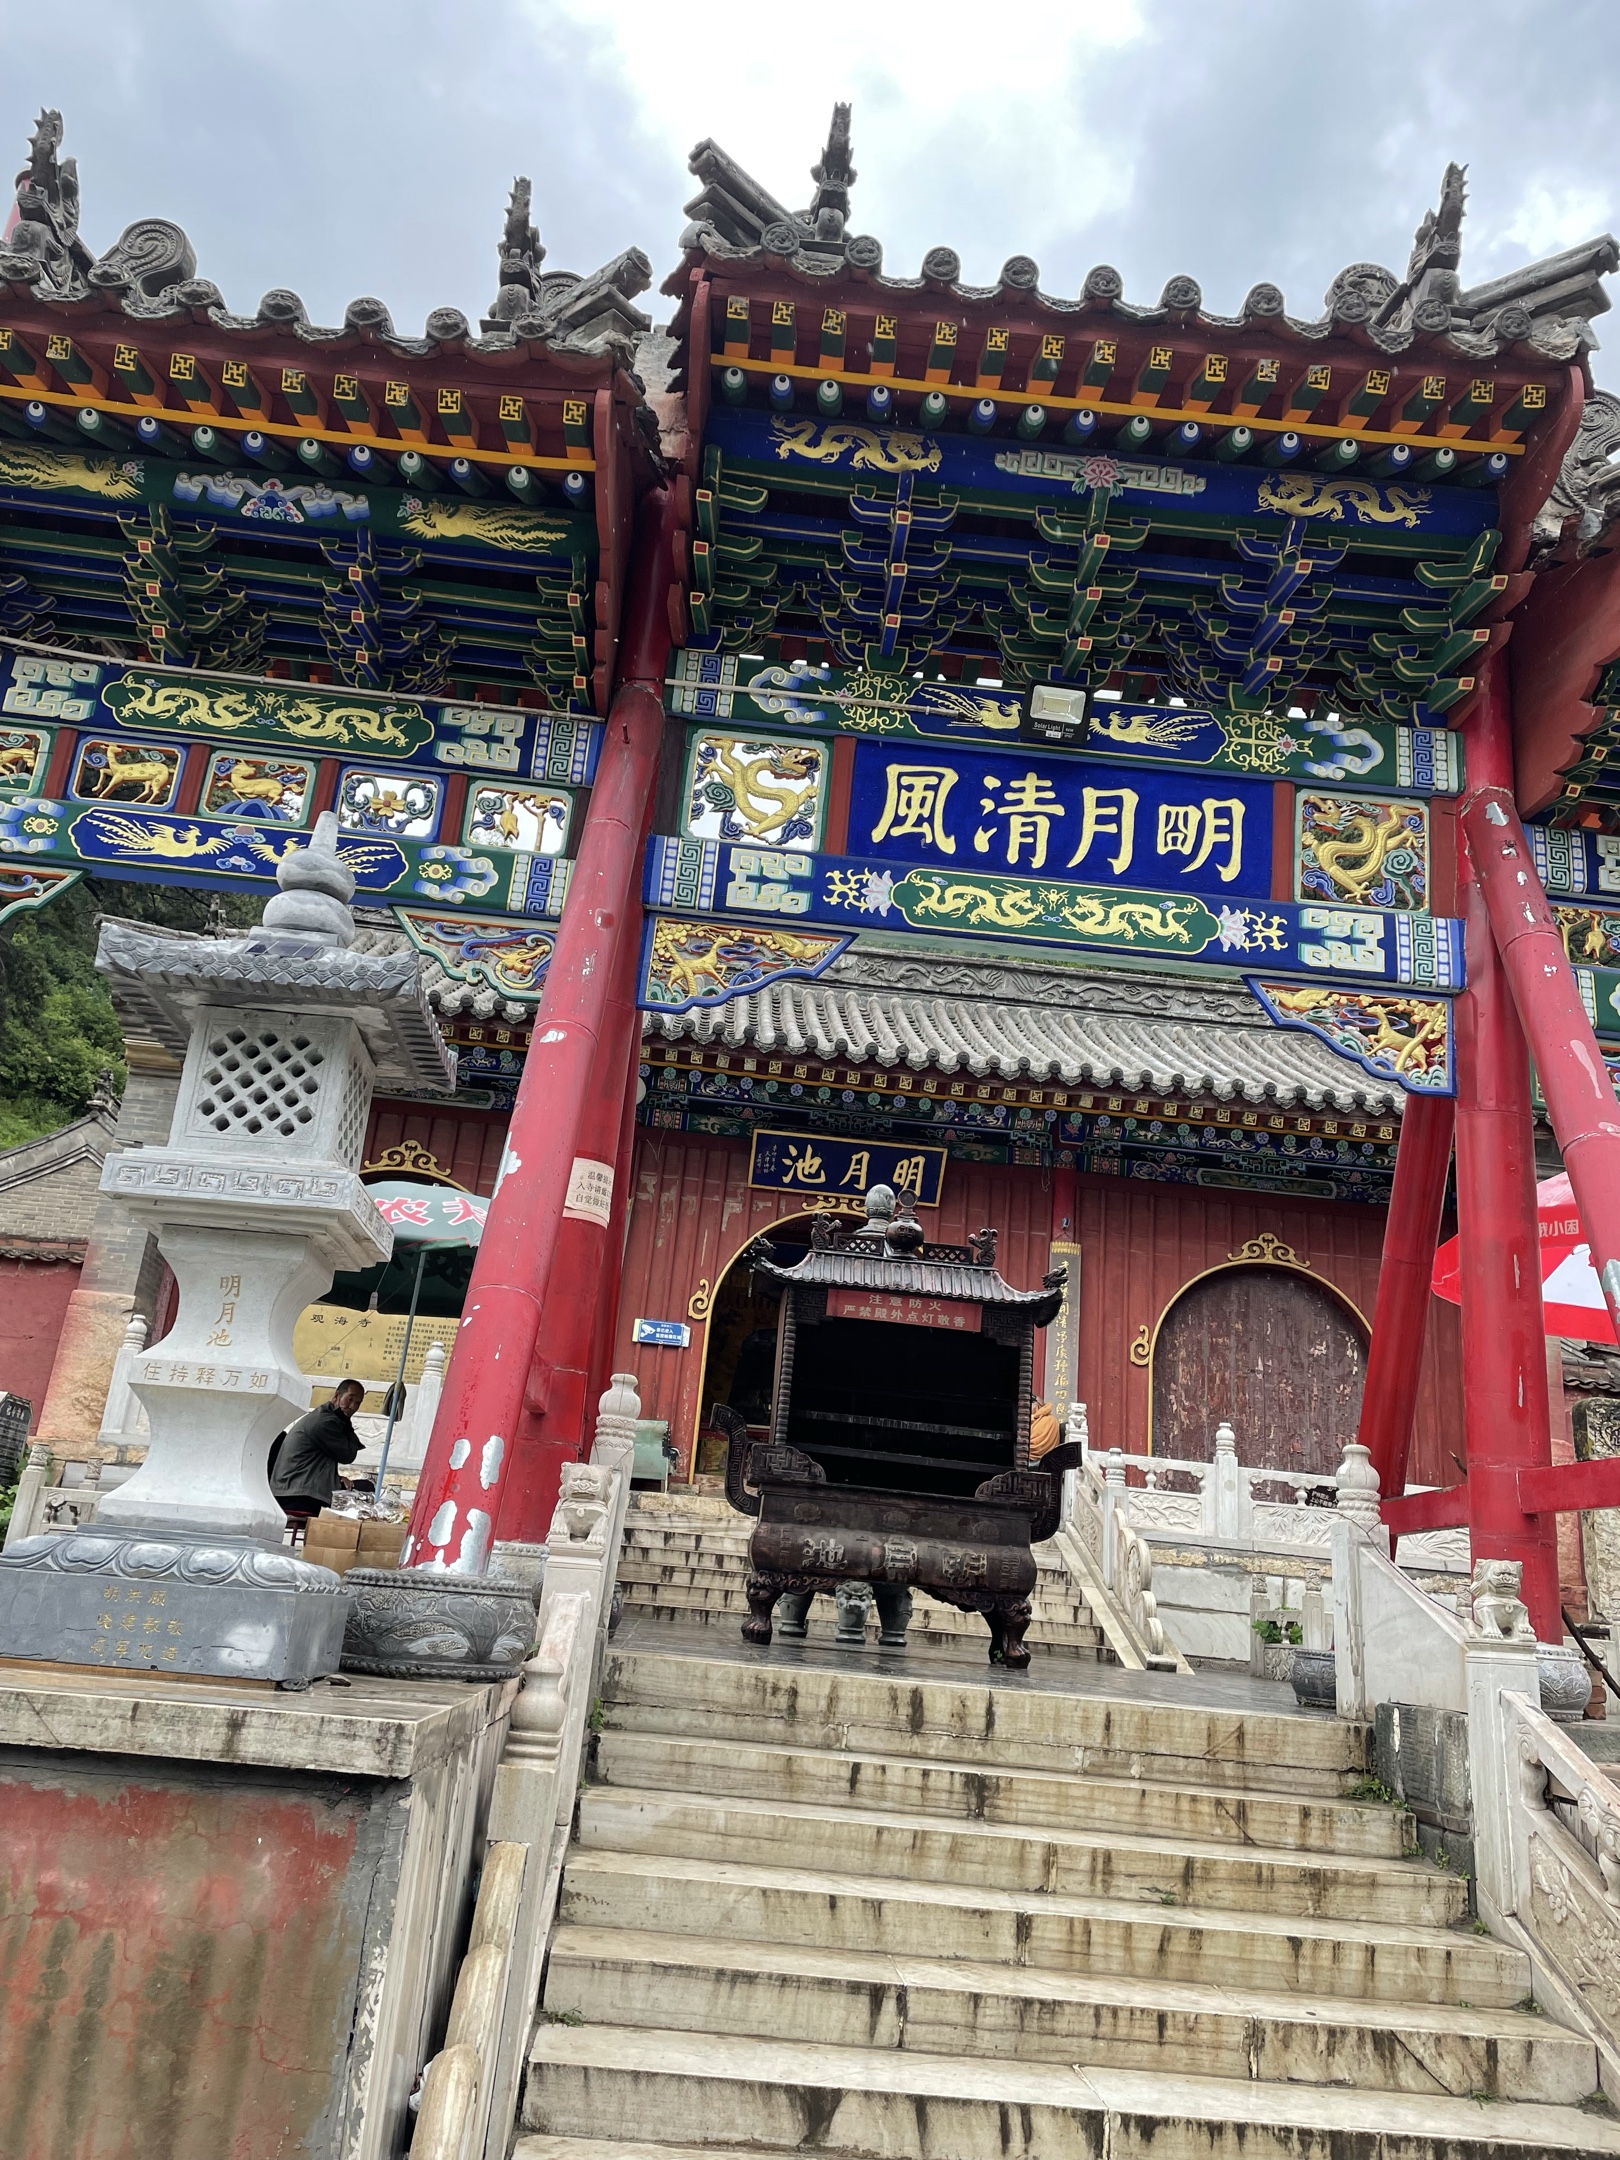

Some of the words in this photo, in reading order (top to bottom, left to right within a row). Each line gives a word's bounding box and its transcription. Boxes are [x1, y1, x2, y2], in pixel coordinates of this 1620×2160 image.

[205, 1274, 242, 1347] 明月池
[868, 1294, 942, 1312] 注意防火
[310, 1314, 372, 1328] 观海寺
[842, 1304, 966, 1328] 严禁殿外点灯敬香
[143, 1362, 269, 1390] 住持释万如
